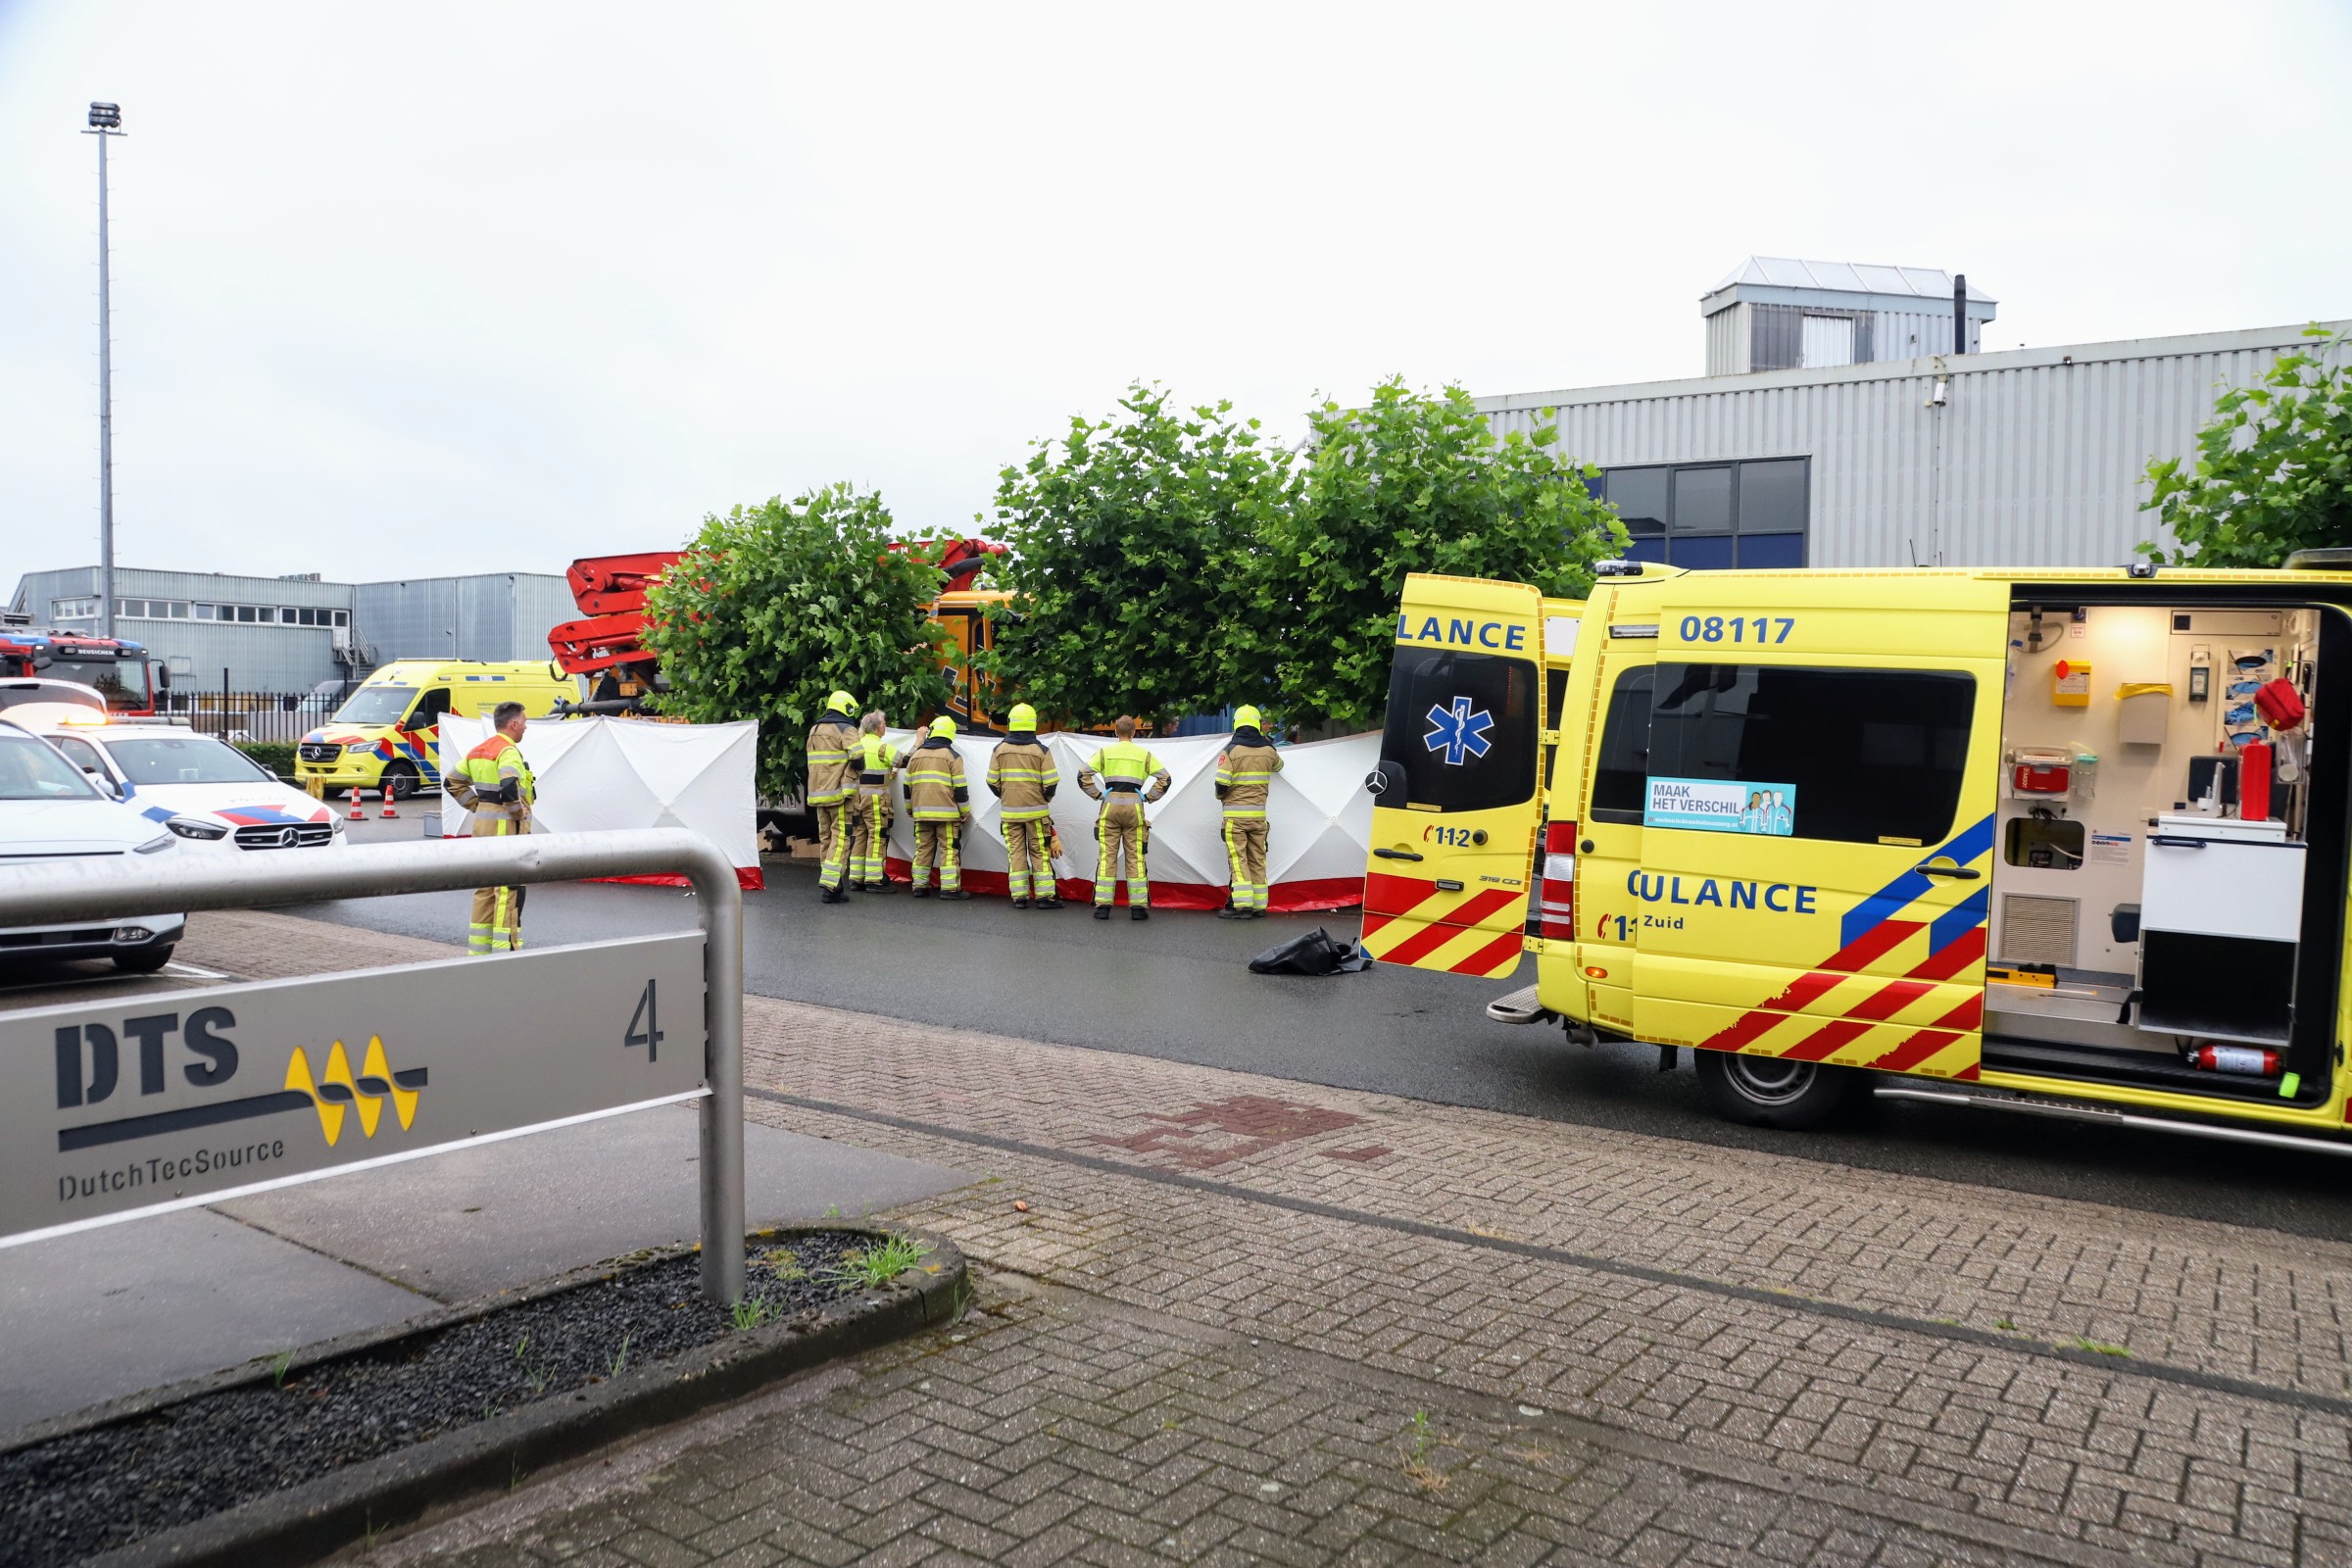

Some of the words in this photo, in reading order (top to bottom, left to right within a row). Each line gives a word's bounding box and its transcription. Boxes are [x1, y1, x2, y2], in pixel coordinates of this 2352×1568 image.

[1396, 614, 1526, 651] LANCE
[1680, 615, 1795, 644] 08117
[1652, 798, 1677, 809] HET
[1680, 799, 1740, 813] VERSCHIL
[1653, 785, 1690, 797] MAAK
[1435, 826, 1471, 848] 1-1-2
[1643, 914, 1685, 930] Zuid
[624, 979, 663, 1063] 4
[55, 1005, 239, 1110] DTS
[59, 1140, 284, 1201] DutchTecSource
